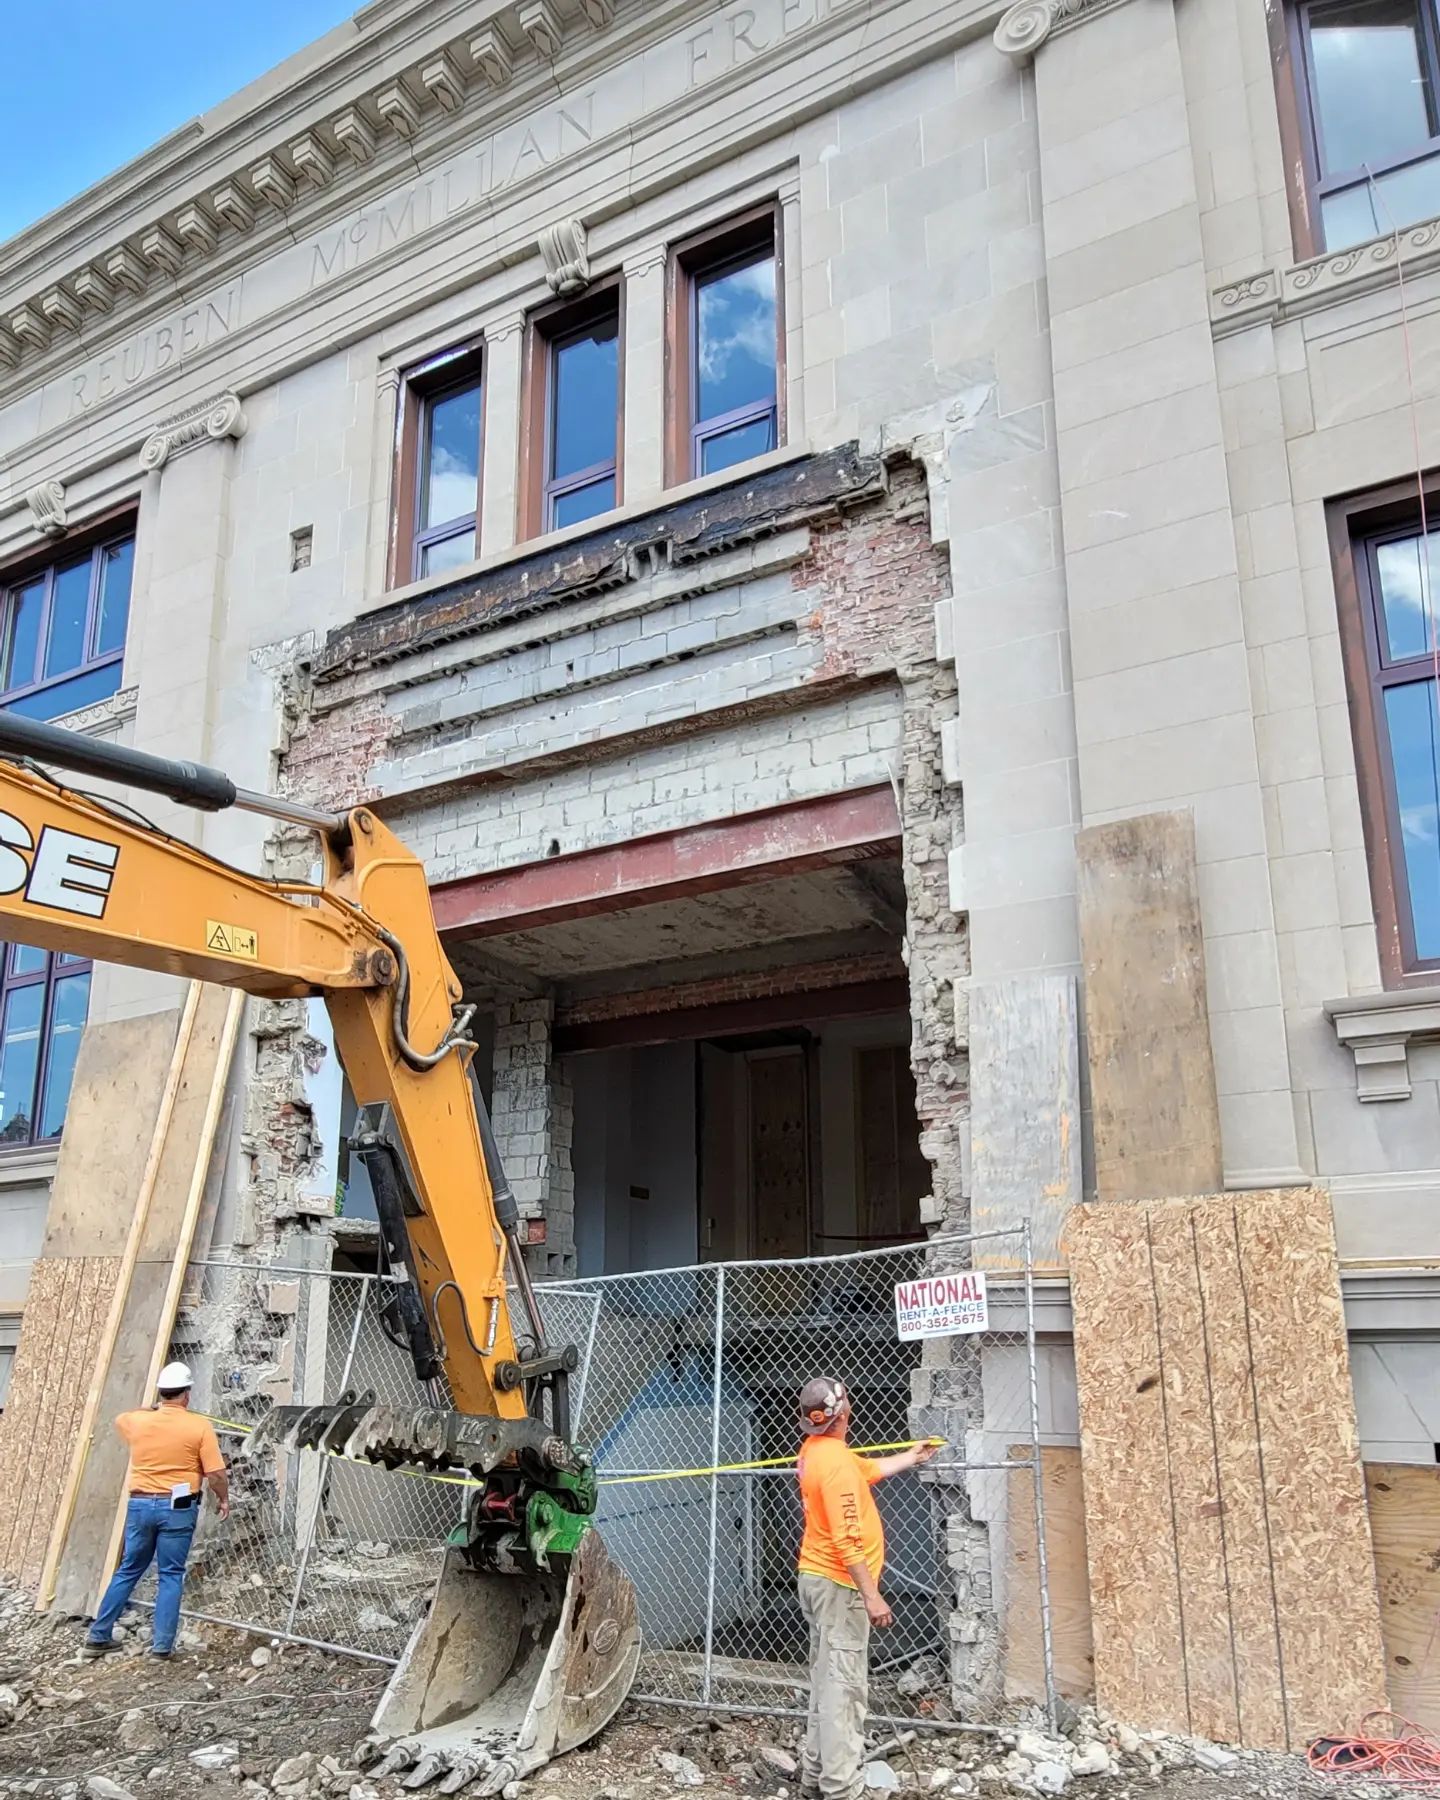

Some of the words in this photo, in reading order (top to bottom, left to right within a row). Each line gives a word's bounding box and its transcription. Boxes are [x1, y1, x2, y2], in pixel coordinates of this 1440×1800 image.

[67, 289, 236, 419] REUBEN
[897, 1275, 983, 1312] NATIONAL
[899, 1301, 985, 1322] RENT-A-FENCE
[900, 1312, 985, 1333] 800-352-5675
